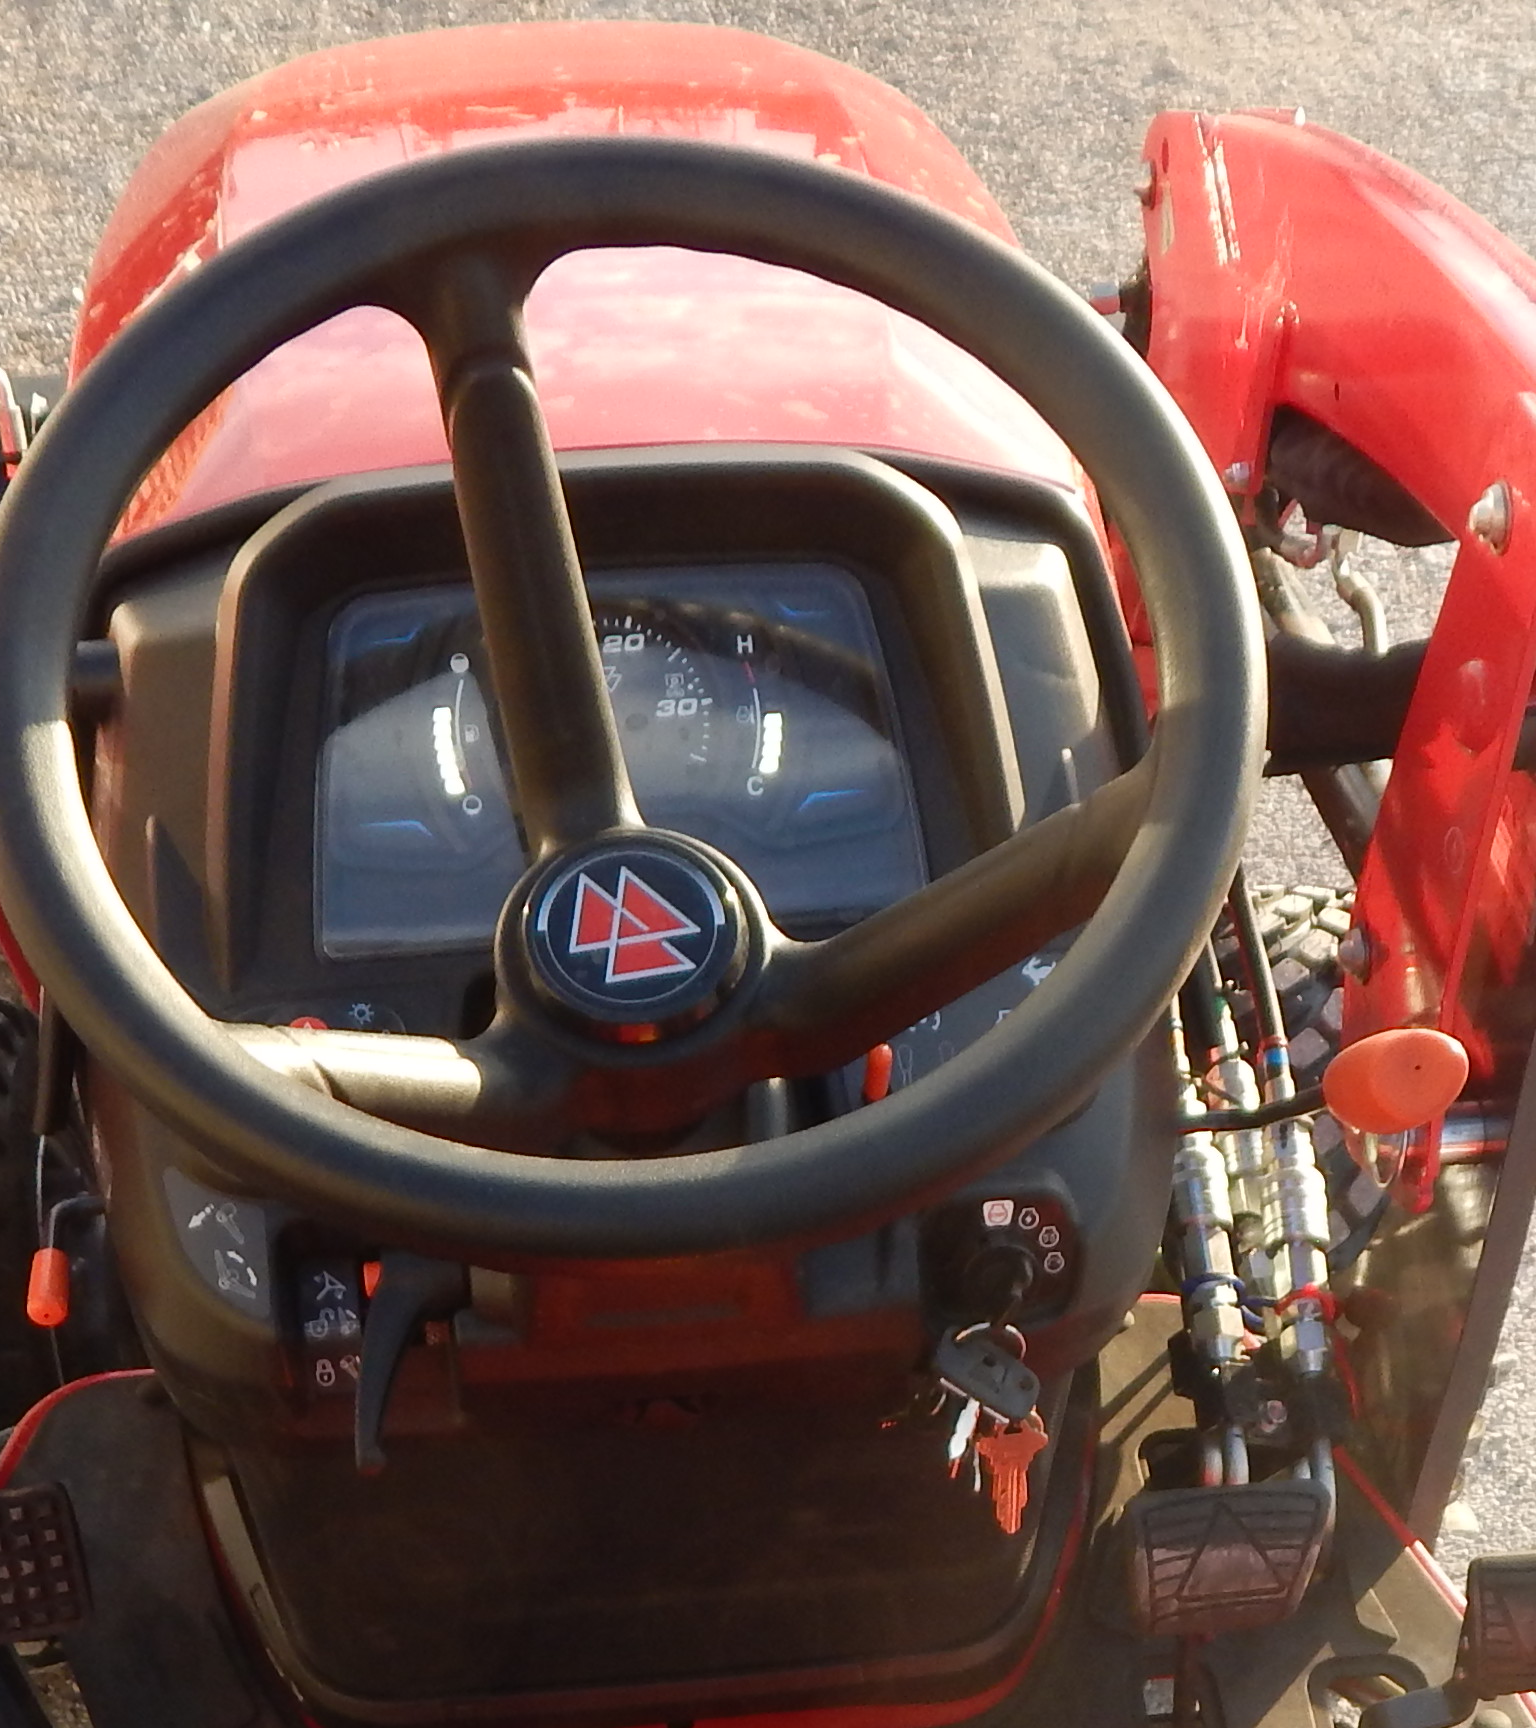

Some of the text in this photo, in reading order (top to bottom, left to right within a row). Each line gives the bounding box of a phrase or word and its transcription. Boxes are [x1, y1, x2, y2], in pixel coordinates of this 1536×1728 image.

[602, 633, 645, 653] 20
[736, 634, 754, 654] H
[655, 698, 698, 718] 30
[746, 776, 764, 796] C
